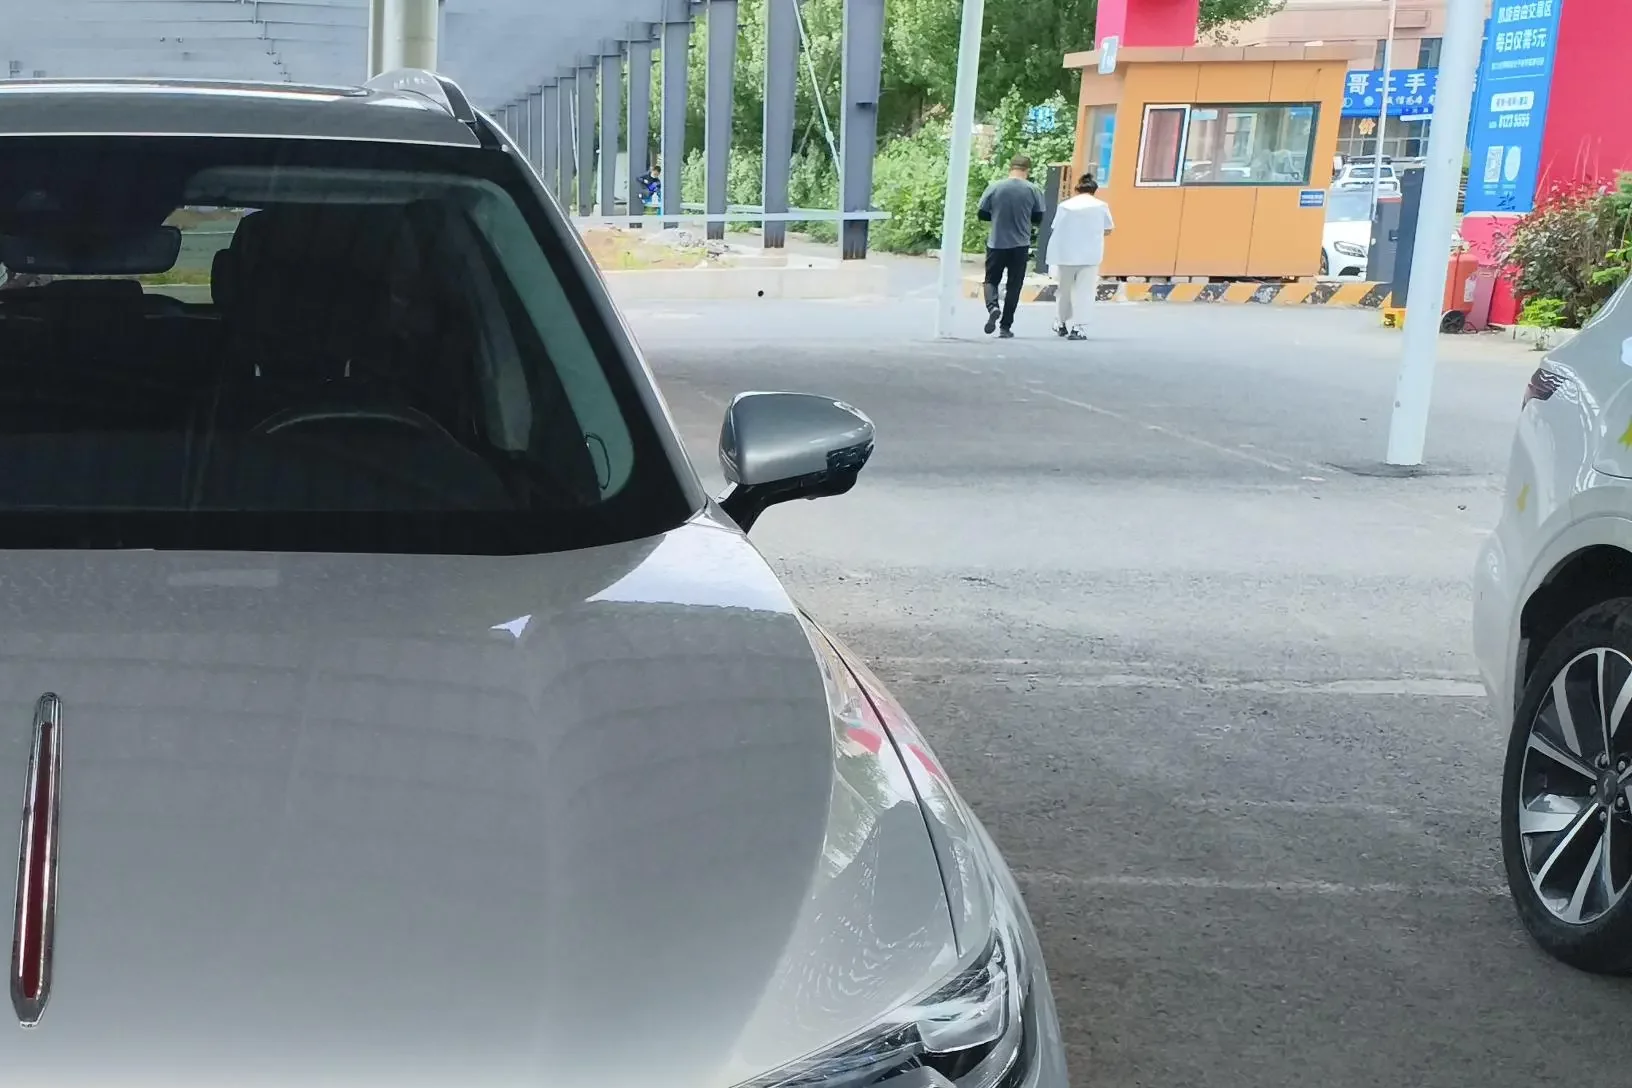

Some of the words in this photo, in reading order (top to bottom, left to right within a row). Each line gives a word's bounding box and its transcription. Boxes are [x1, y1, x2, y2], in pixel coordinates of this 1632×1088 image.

[1495, 28, 1547, 52] 每日仅需5元
